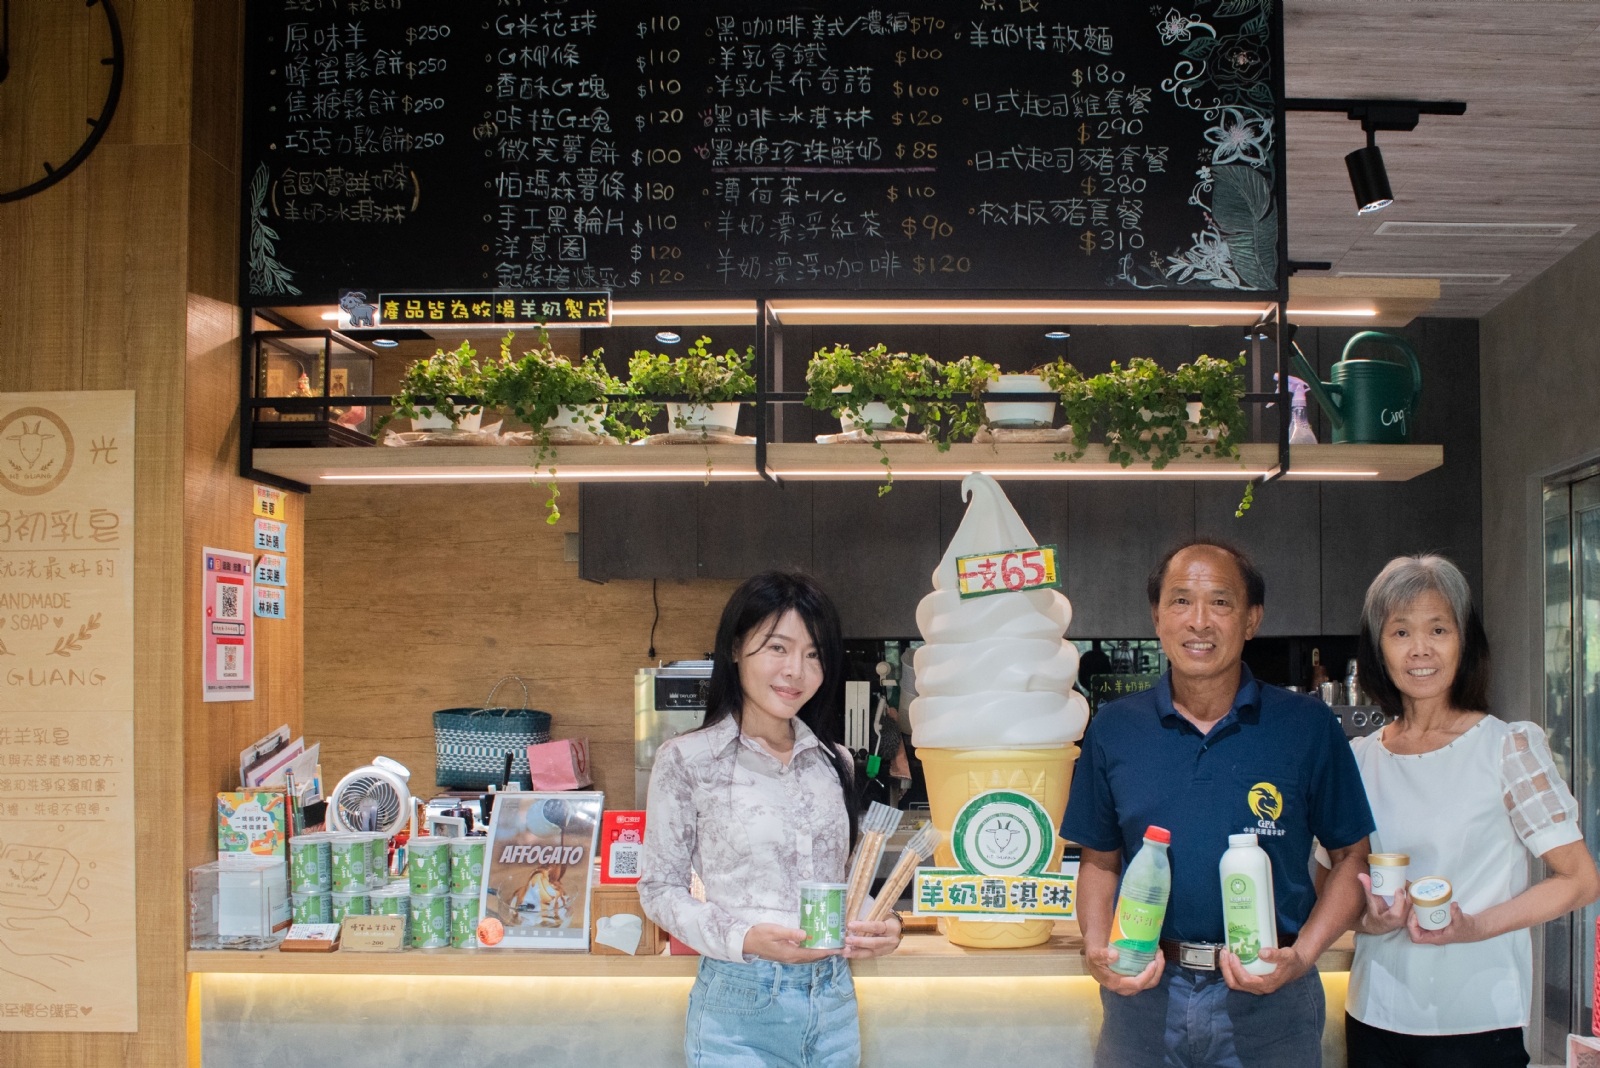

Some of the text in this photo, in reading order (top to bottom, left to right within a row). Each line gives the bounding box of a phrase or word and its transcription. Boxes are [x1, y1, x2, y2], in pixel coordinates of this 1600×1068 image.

[285, 21, 367, 52] 原味羊
[496, 9, 597, 38] G米花球
[285, 49, 404, 87] 蜂蜜鬆餅
[498, 43, 580, 68] G柳條
[720, 43, 827, 70] 羊乳拿鐵
[497, 73, 610, 99] 香酥G塊
[715, 66, 874, 98] 羊乳卡布奇諾
[1071, 64, 1126, 88] $180
[285, 88, 399, 122] 焦糖鬆餅
[975, 86, 1152, 118] 日式起司雞套餐
[285, 125, 406, 157] 巧克力鬆餅
[498, 134, 620, 165] 微笑薯餅
[711, 135, 882, 166] 黑糖珍珠鮮奶
[975, 144, 1169, 176] 日式起司豬套餐
[495, 167, 626, 203] 帕瑪森薯條
[1080, 175, 1147, 196] $280
[498, 205, 624, 235] 手工黑輪片
[717, 210, 884, 245] 羊奶漂浮紅茶
[977, 197, 1144, 231] 松板豬套餐
[1079, 230, 1145, 256] $310
[716, 248, 902, 284] 羊奶漂浮咖啡
[383, 299, 607, 320] 產品皆為牧場羊奶製成
[90, 435, 118, 465] 光
[10, 613, 49, 631] SOAP
[7, 667, 107, 686] GUANG
[1257, 819, 1276, 829] GFA
[499, 845, 584, 866] AFFOGATO
[920, 879, 1073, 909] 羊奶霜淇淋
